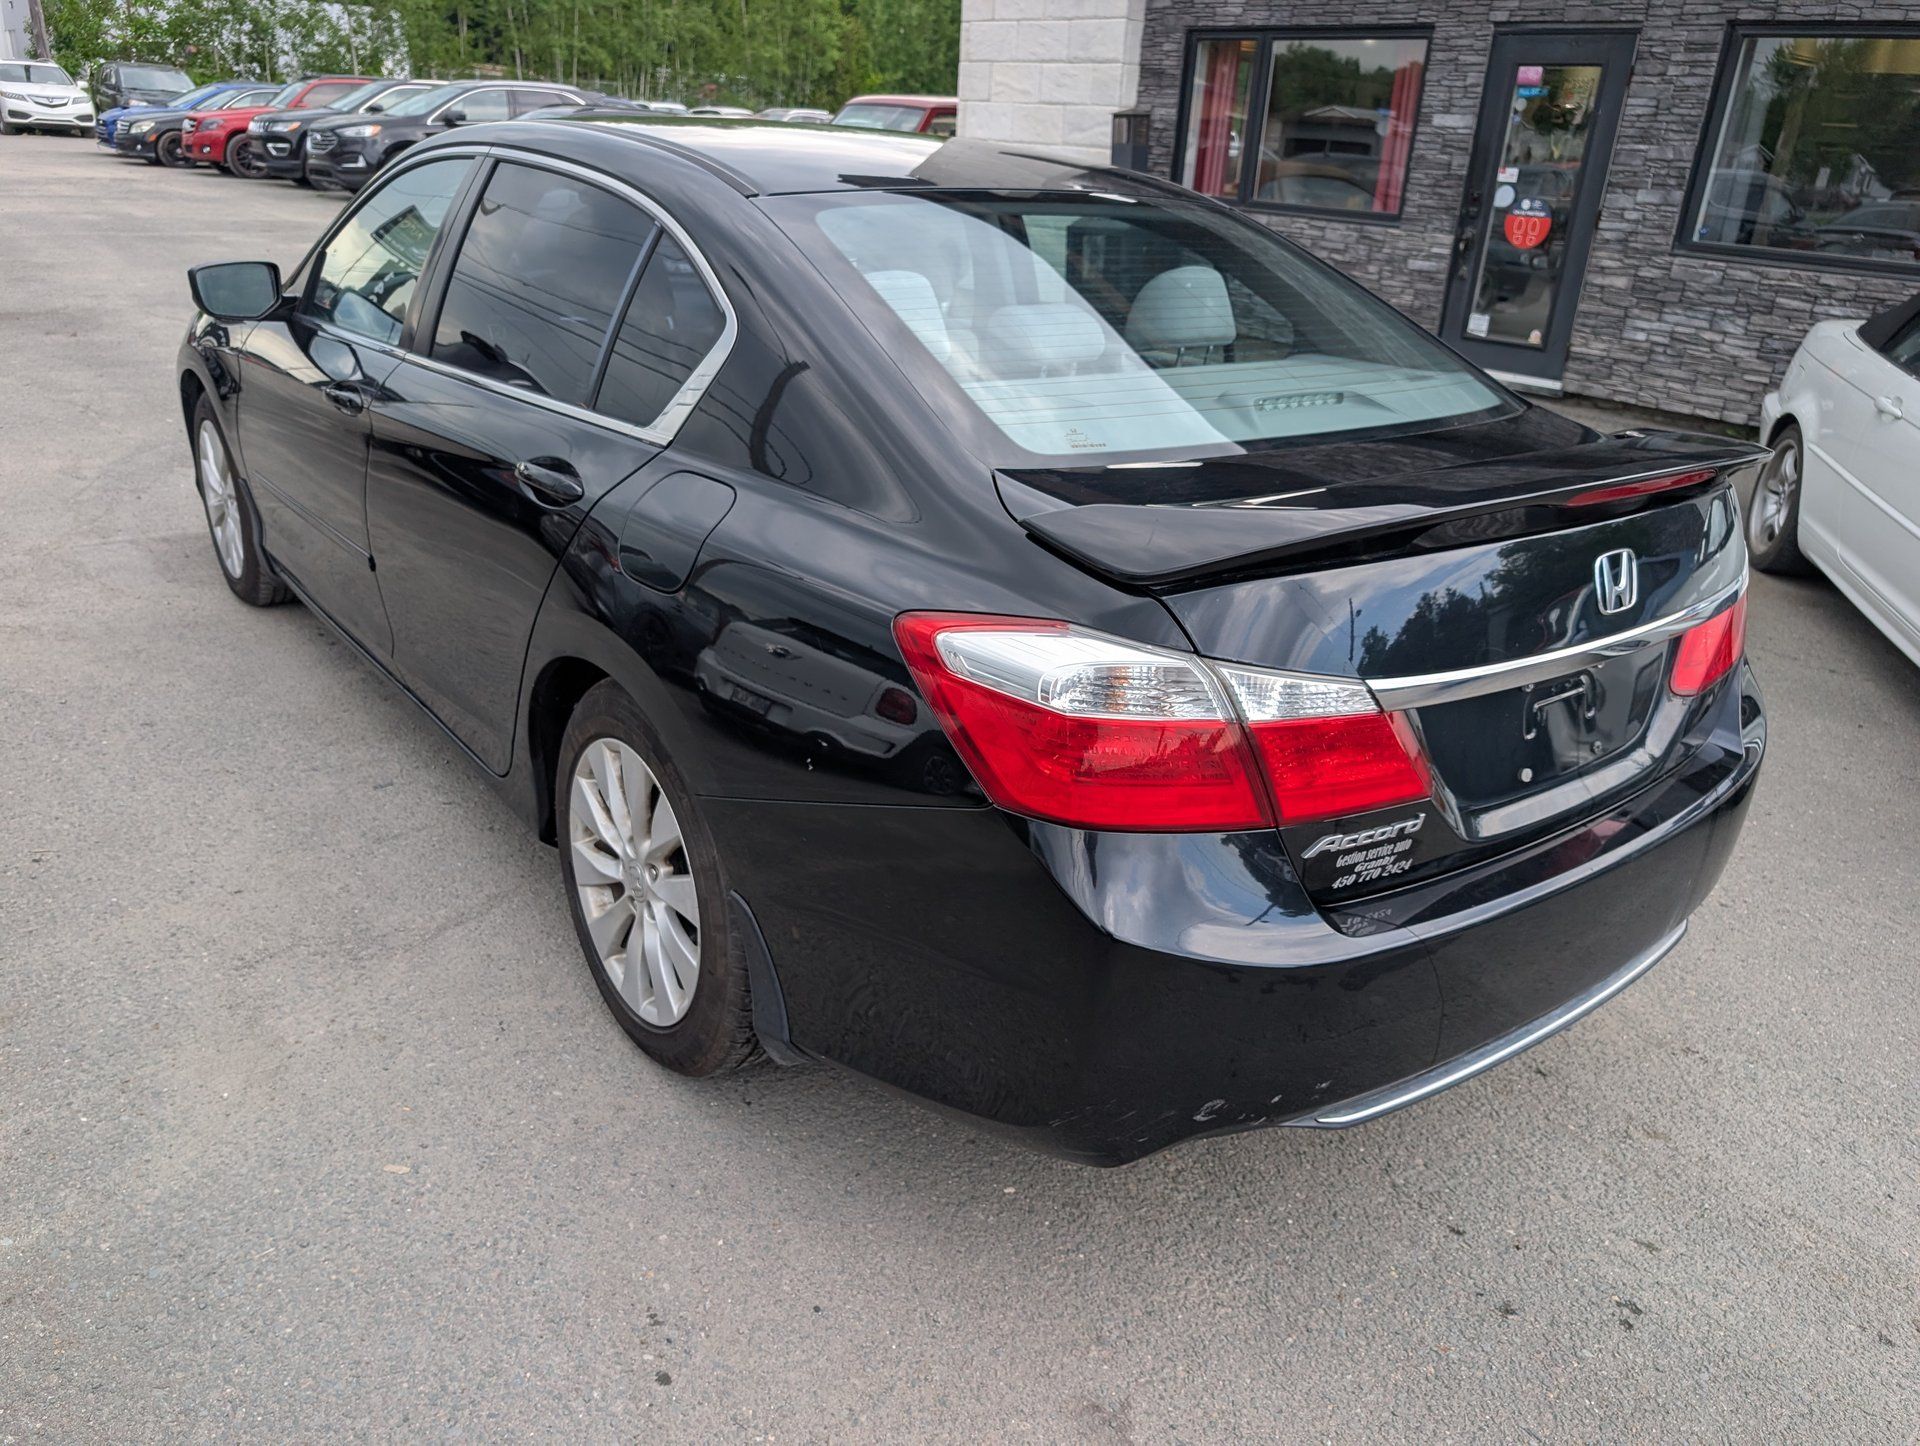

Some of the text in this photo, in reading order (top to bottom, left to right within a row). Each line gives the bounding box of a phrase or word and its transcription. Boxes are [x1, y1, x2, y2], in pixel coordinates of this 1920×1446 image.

[1301, 812, 1426, 859] Accord
[1336, 838, 1413, 868] Gestion service auto
[1331, 858, 1413, 889] 450 770 2424
